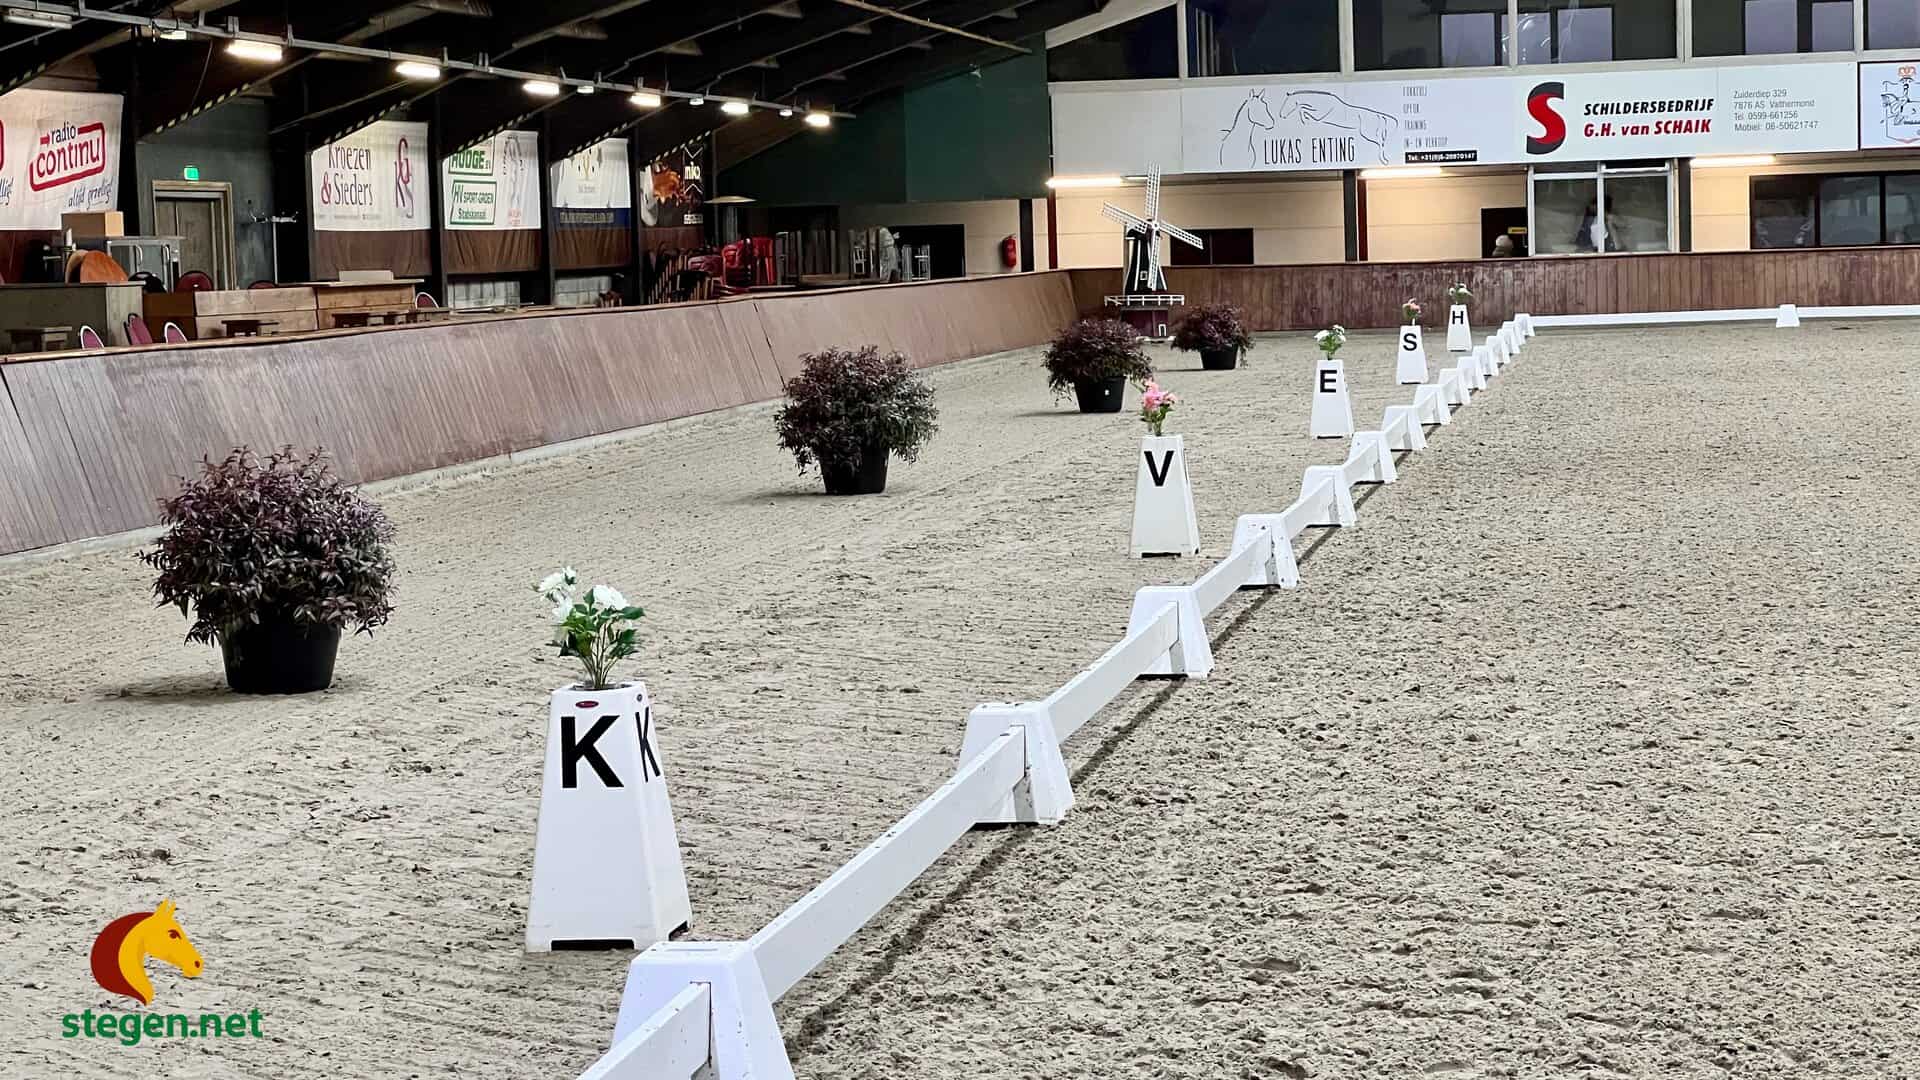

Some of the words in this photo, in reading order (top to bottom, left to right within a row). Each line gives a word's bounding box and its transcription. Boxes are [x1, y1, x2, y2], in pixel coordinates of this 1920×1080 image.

[1733, 90, 1771, 99] Zuiderdiep
[1772, 89, 1787, 97] 329
[1755, 101, 1765, 109] AS
[1584, 98, 1714, 115] SCHILDERSBEDRIJF
[51, 120, 76, 144] radio
[1584, 123, 1616, 137] G.H.
[1621, 125, 1650, 135] van
[1654, 119, 1711, 135] SCHAIK
[36, 138, 100, 178] continu
[328, 143, 372, 170] Kroezen
[1264, 138, 1301, 165] LUKAS
[1311, 137, 1355, 163] ENTING
[321, 171, 332, 204] &
[334, 173, 373, 206] Sieders
[1452, 311, 1464, 324] H
[1403, 333, 1417, 351] S
[1320, 370, 1337, 393] E
[1144, 450, 1174, 487] V
[561, 715, 624, 788] K
[635, 706, 660, 783] K
